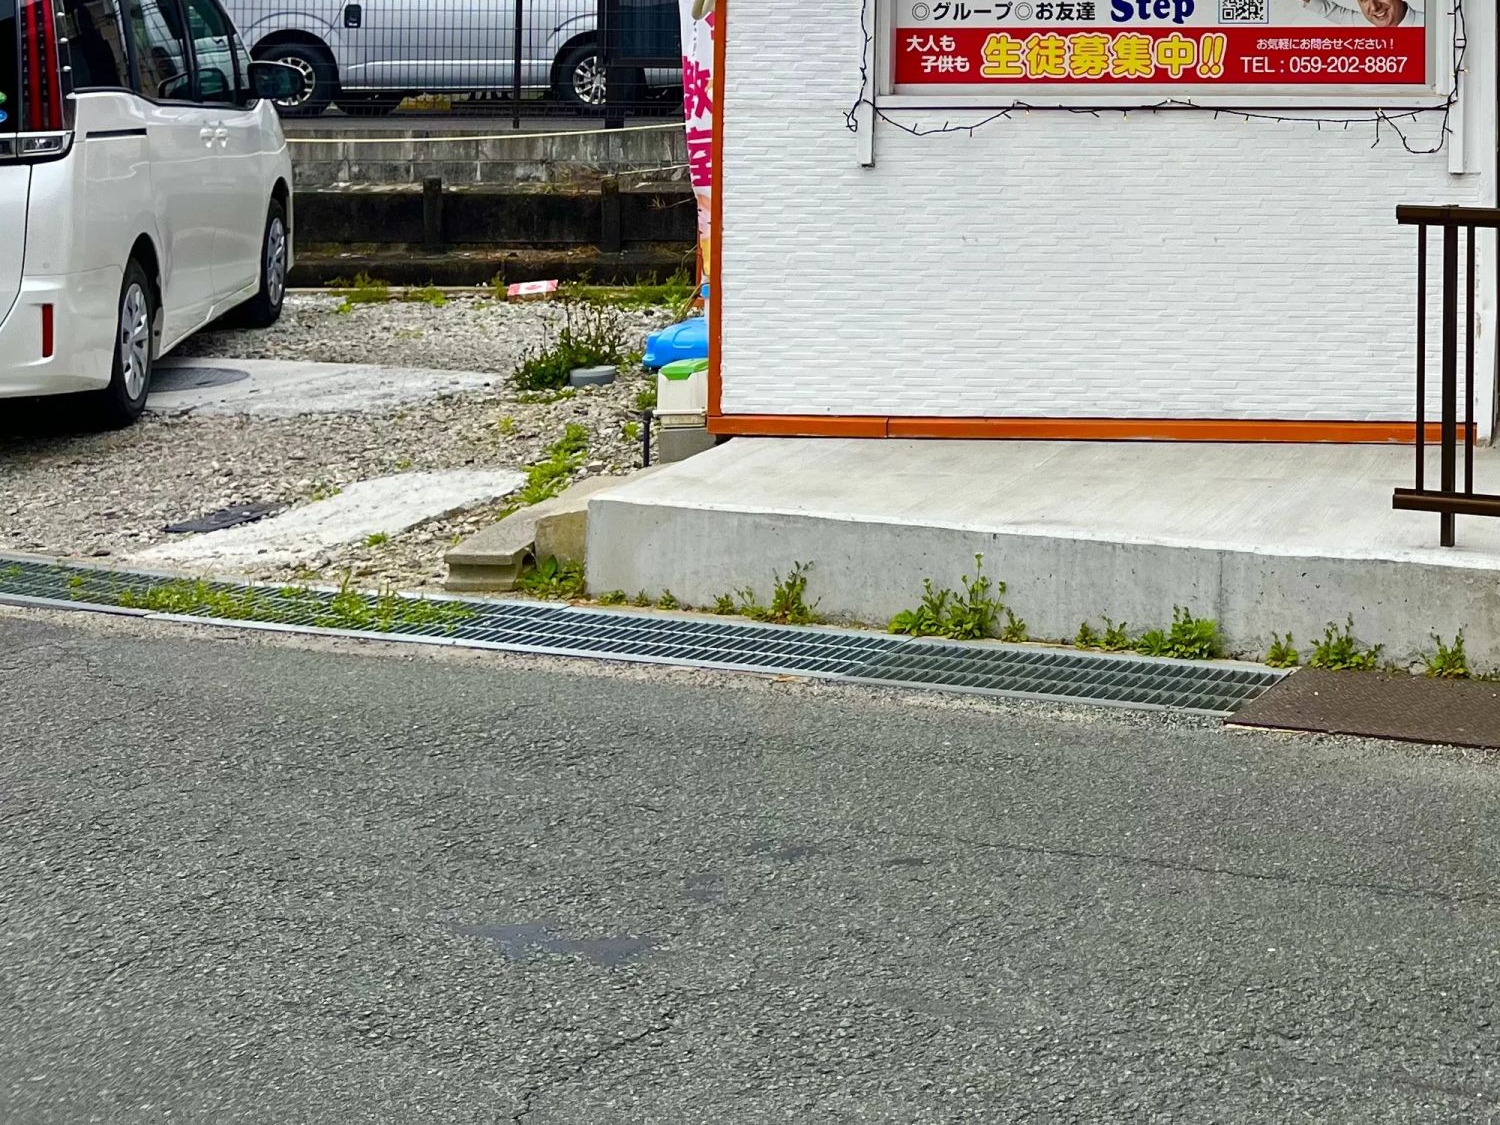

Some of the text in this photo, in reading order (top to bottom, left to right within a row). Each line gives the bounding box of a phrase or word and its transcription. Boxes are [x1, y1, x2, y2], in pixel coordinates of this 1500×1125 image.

[906, 35, 956, 52] 大人も
[921, 55, 970, 73] 子供も
[1289, 56, 1408, 73] 059-202-8867
